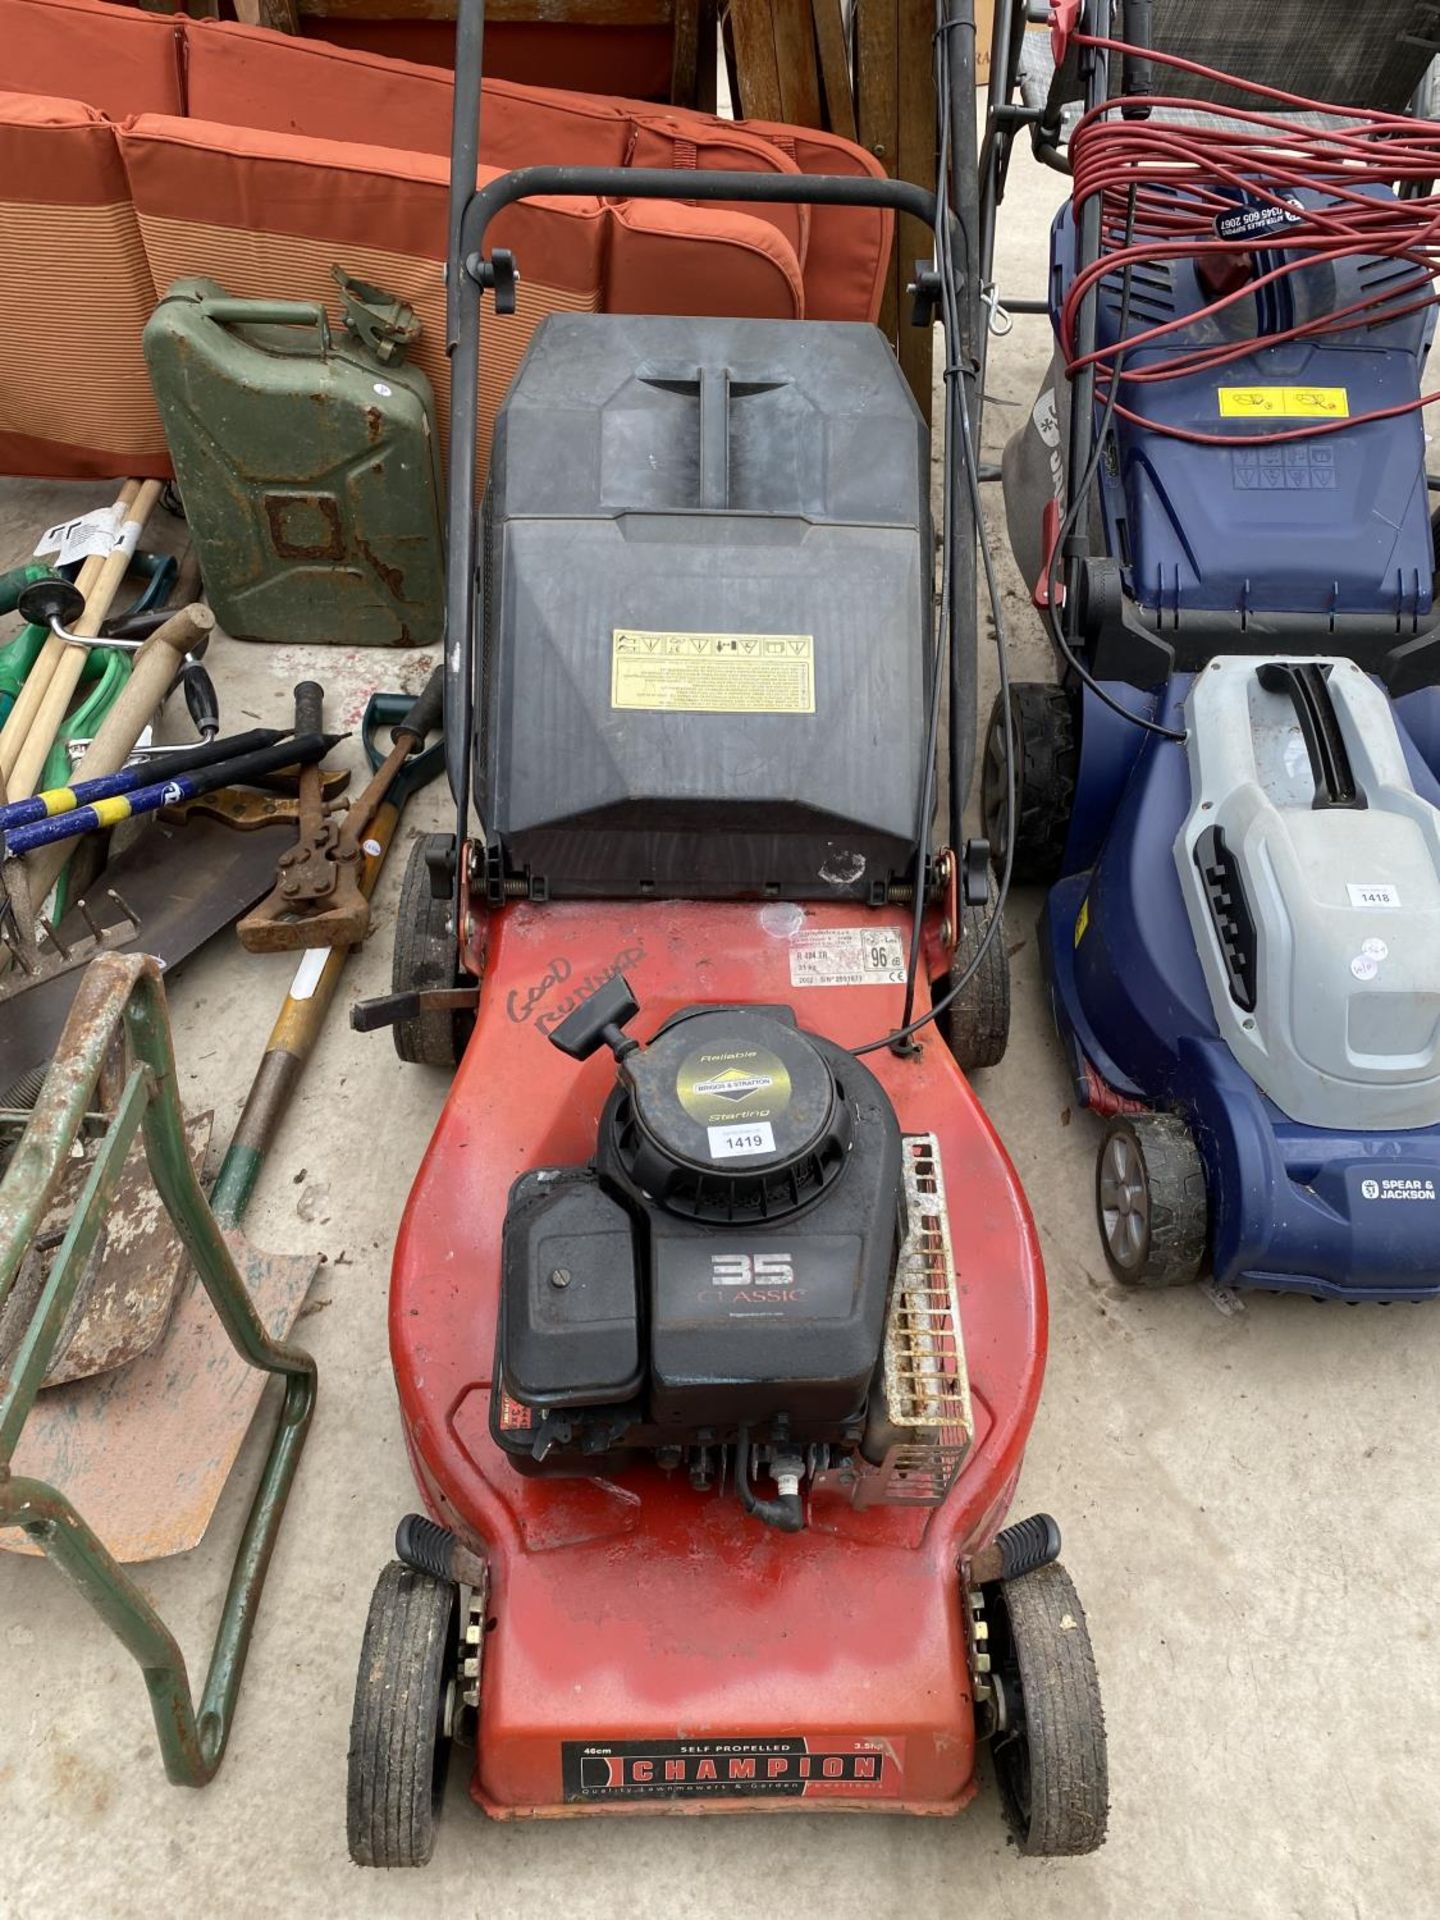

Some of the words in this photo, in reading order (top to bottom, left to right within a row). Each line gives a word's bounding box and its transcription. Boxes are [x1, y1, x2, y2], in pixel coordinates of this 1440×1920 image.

[1221, 217, 1241, 230] 2067
[1243, 211, 1260, 224] 605
[1266, 215, 1284, 225] AFTER
[1222, 225, 1246, 236] SUPPORT
[1248, 220, 1266, 230] SALES
[1362, 893, 1390, 902] 1418
[871, 947, 888, 967] 96
[507, 957, 572, 1023] GOOD
[700, 1051, 758, 1063] Reliable
[708, 1109, 771, 1122] Starting
[726, 1135, 763, 1150] 1419
[1382, 1180, 1422, 1190] SPEAR
[1425, 1180, 1434, 1190] &
[1380, 1189, 1436, 1200] JACKSON
[711, 1253, 794, 1285] 35
[583, 1747, 612, 1755] 46cm
[715, 1744, 791, 1752] PROPELLED
[632, 1757, 875, 1781] CHAMPION
[581, 1786, 632, 1795] Quality
[750, 1782, 799, 1790] Garden
